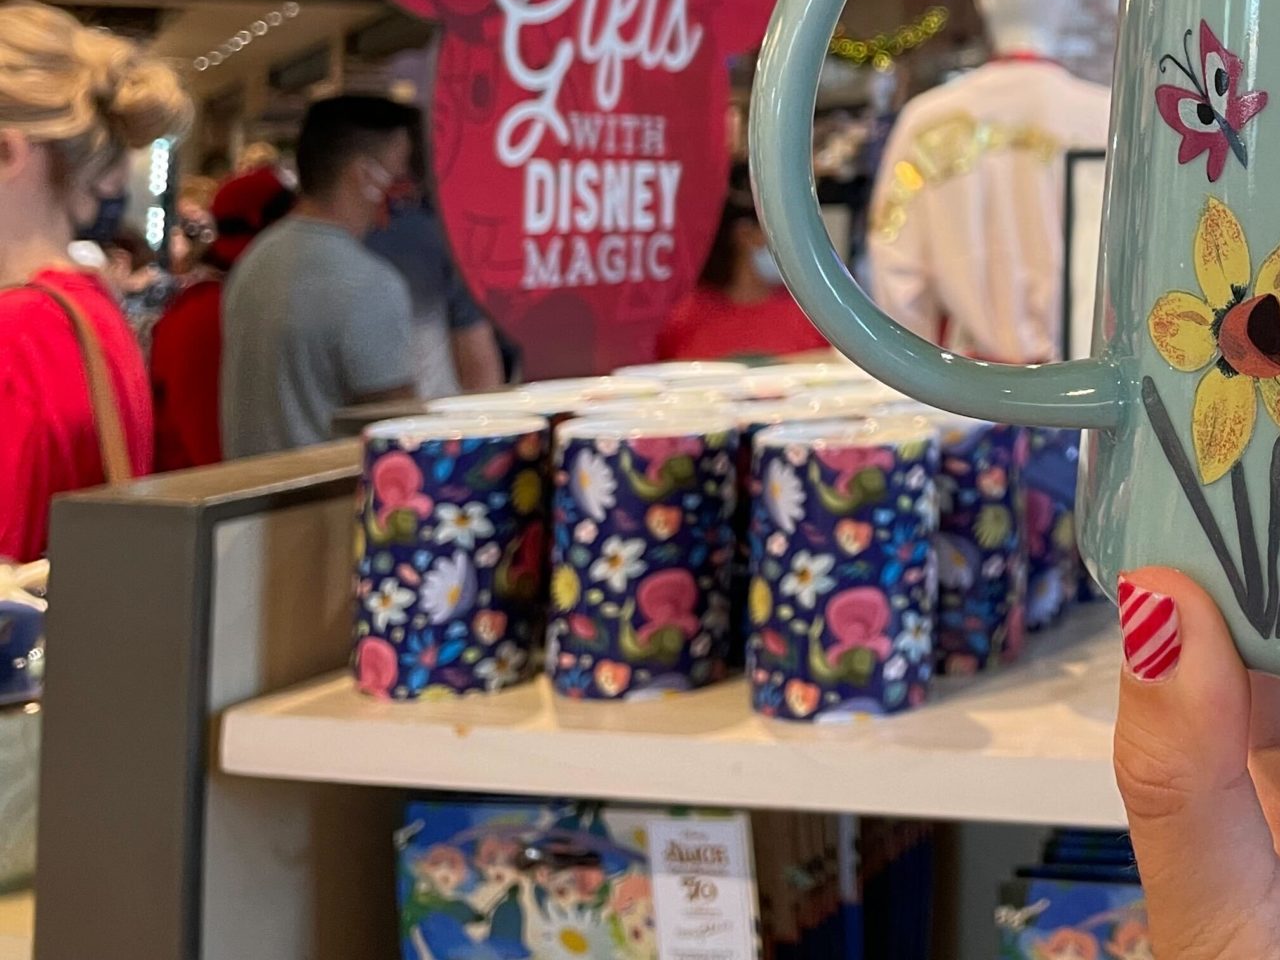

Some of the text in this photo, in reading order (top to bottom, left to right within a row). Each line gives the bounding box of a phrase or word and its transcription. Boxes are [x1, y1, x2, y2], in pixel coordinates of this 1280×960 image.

[571, 114, 666, 156] WITH
[522, 158, 683, 236] DISNEY
[521, 233, 676, 291] MAGIC
